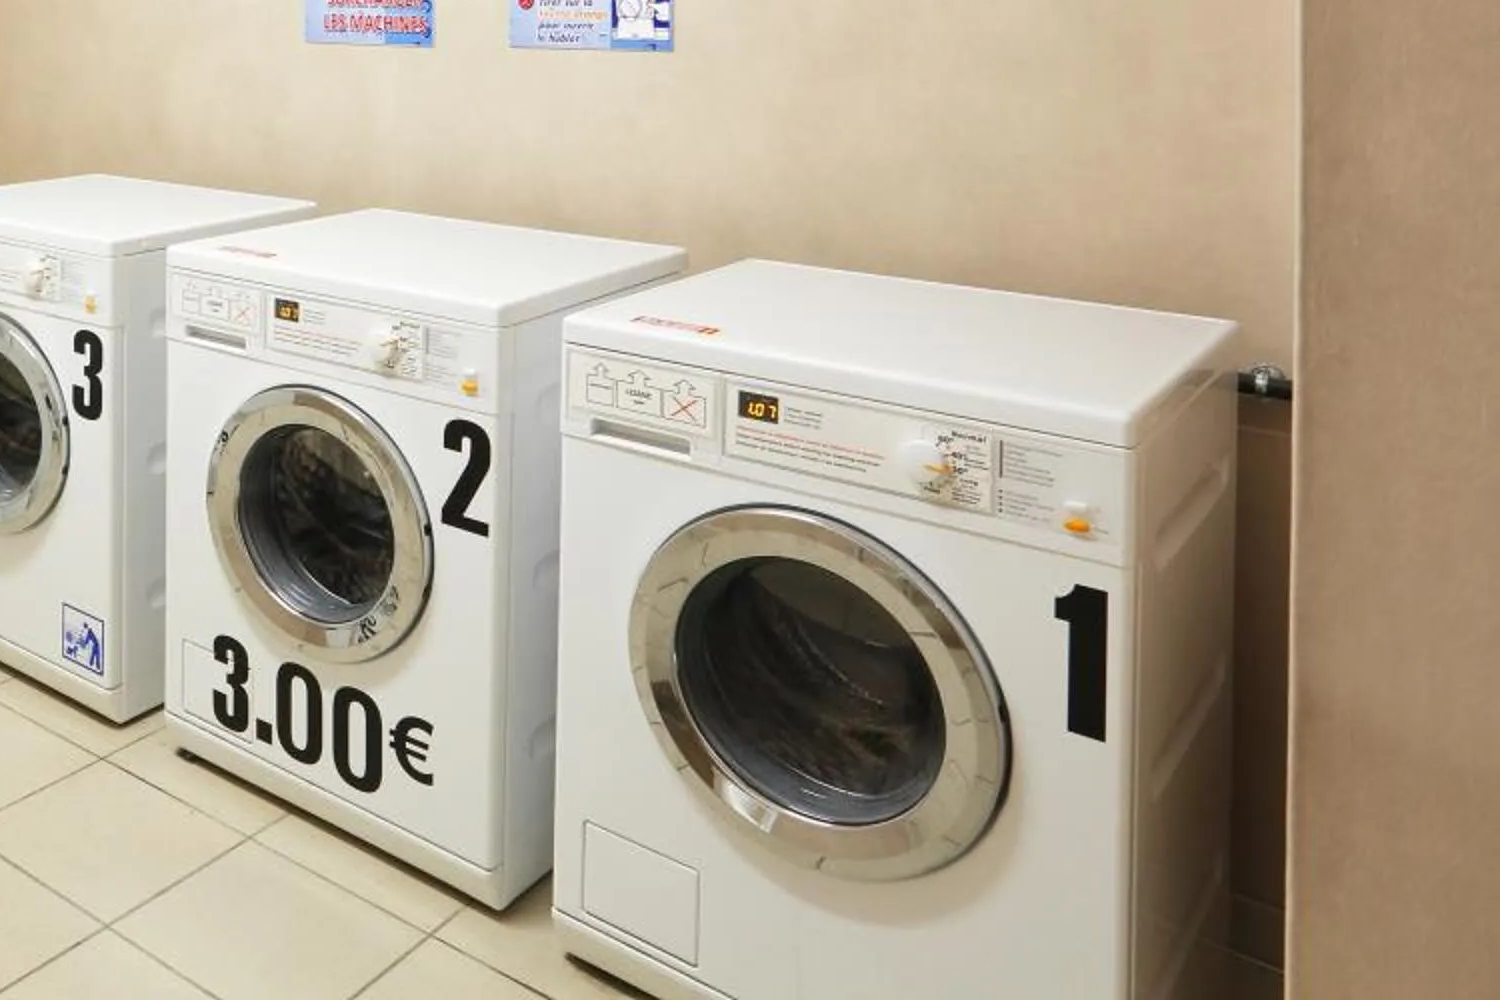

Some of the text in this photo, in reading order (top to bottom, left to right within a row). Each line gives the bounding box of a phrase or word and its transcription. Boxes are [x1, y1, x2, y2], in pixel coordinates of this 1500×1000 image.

[323, 13, 428, 33] LES MACHINES
[72, 329, 103, 421] 3
[440, 418, 492, 538] 2
[212, 633, 435, 793] 3.00€
[1054, 582, 1109, 744] 1
